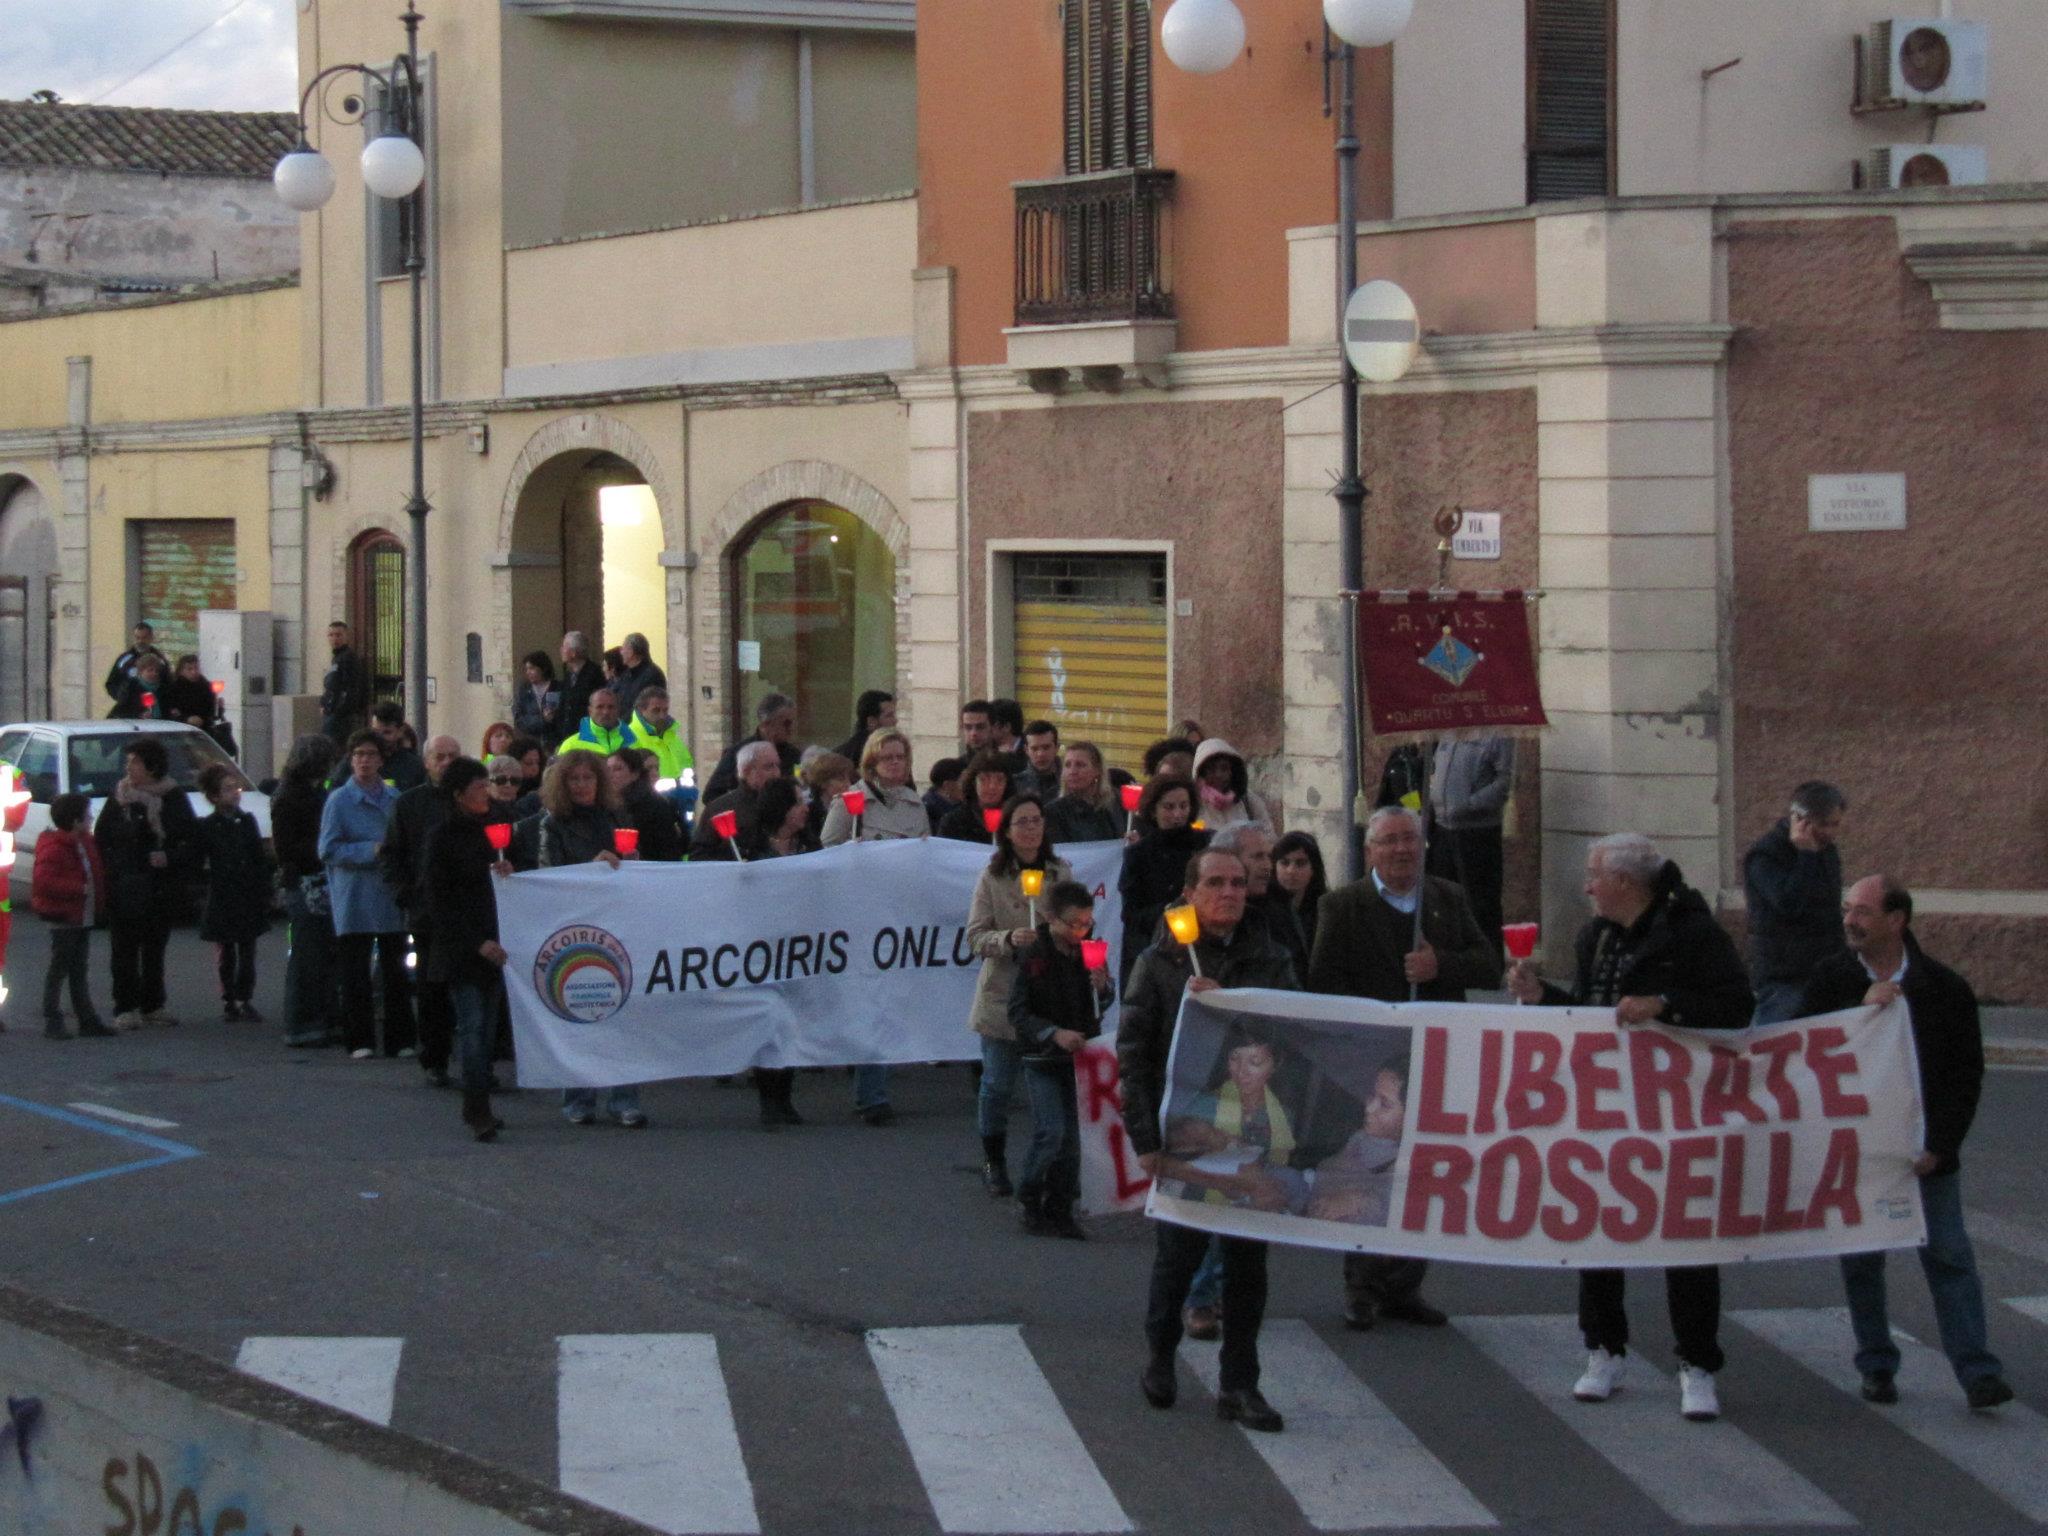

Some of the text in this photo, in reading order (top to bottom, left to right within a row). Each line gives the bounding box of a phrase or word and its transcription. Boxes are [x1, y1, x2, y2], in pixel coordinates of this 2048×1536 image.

[1468, 519, 1483, 533] VIA
[536, 930, 607, 972] ARCOIRIS
[645, 925, 977, 994] ARCOIRIS ONLU
[1416, 1026, 1869, 1135] LIBERATE
[1401, 1128, 1863, 1243] ROSSELLA
